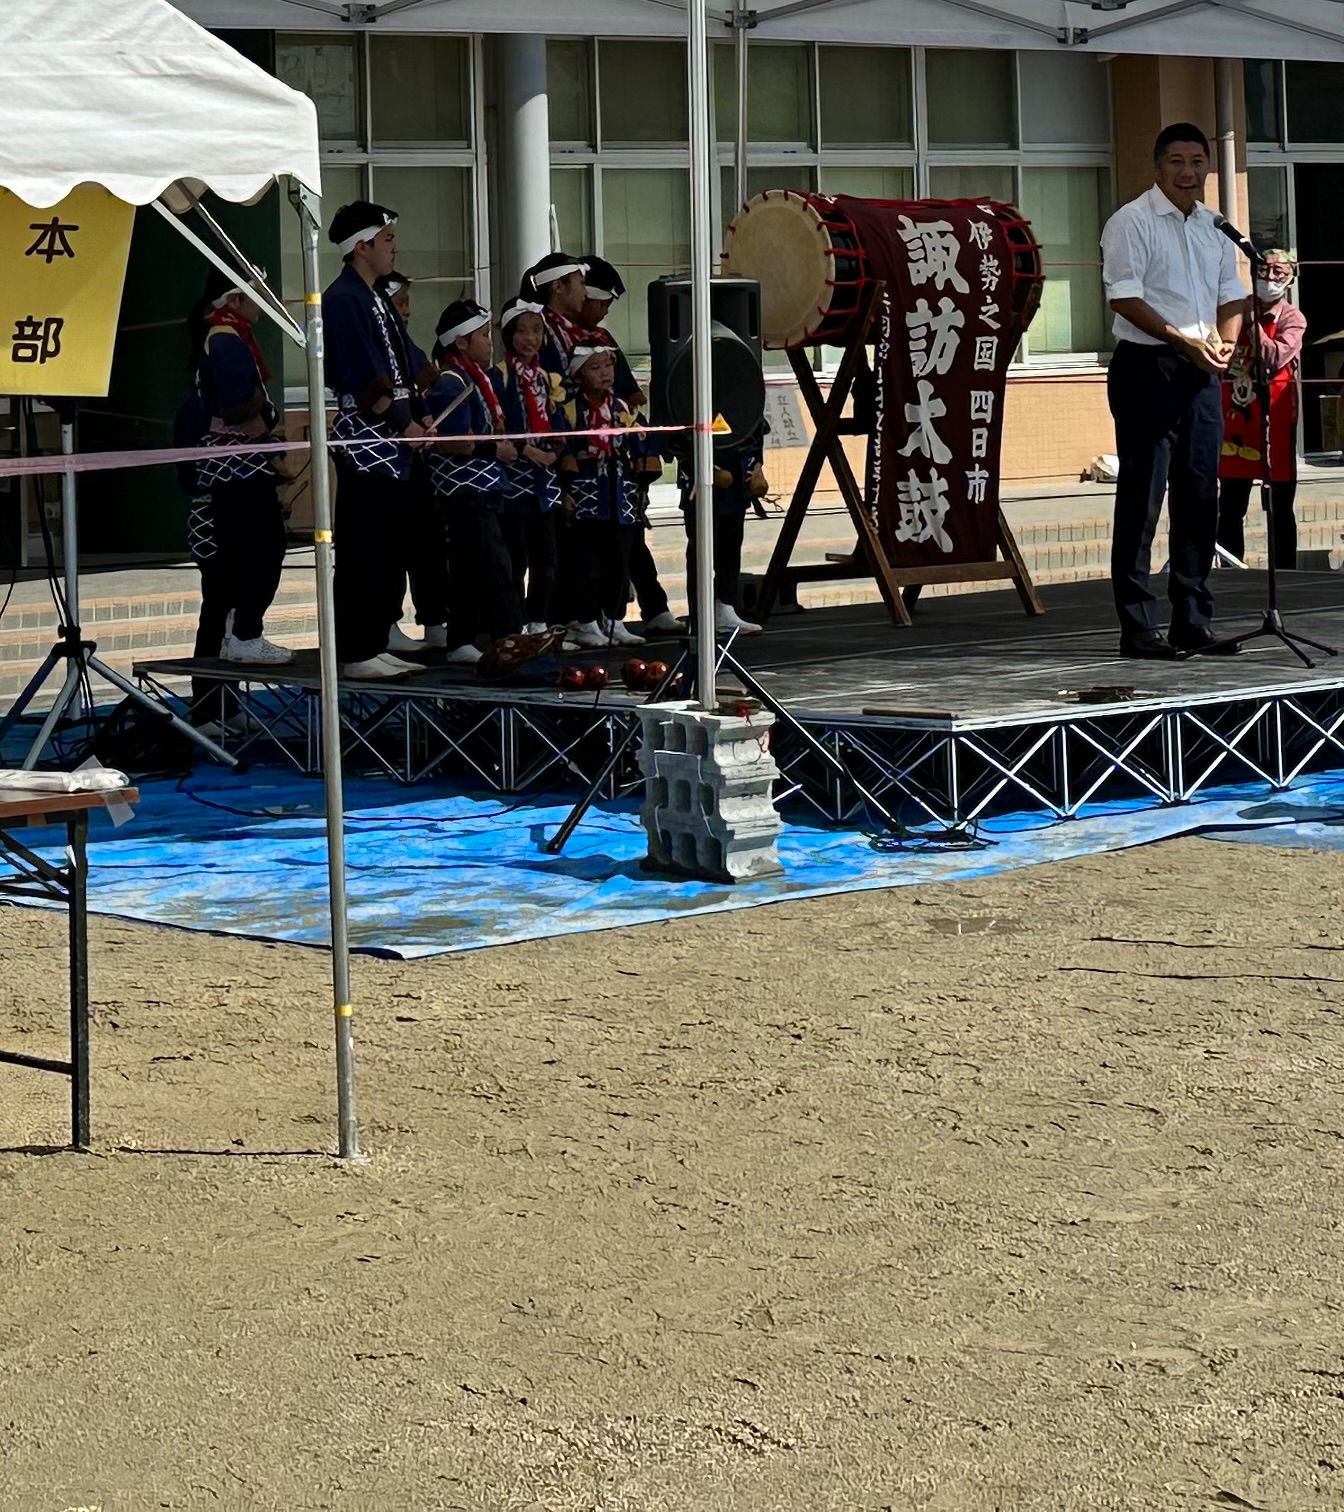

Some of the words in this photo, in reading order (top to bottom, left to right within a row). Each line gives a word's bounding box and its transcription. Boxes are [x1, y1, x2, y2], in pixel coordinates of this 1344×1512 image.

[10, 216, 80, 365] 本部
[894, 214, 971, 554] 諏訪太鼓
